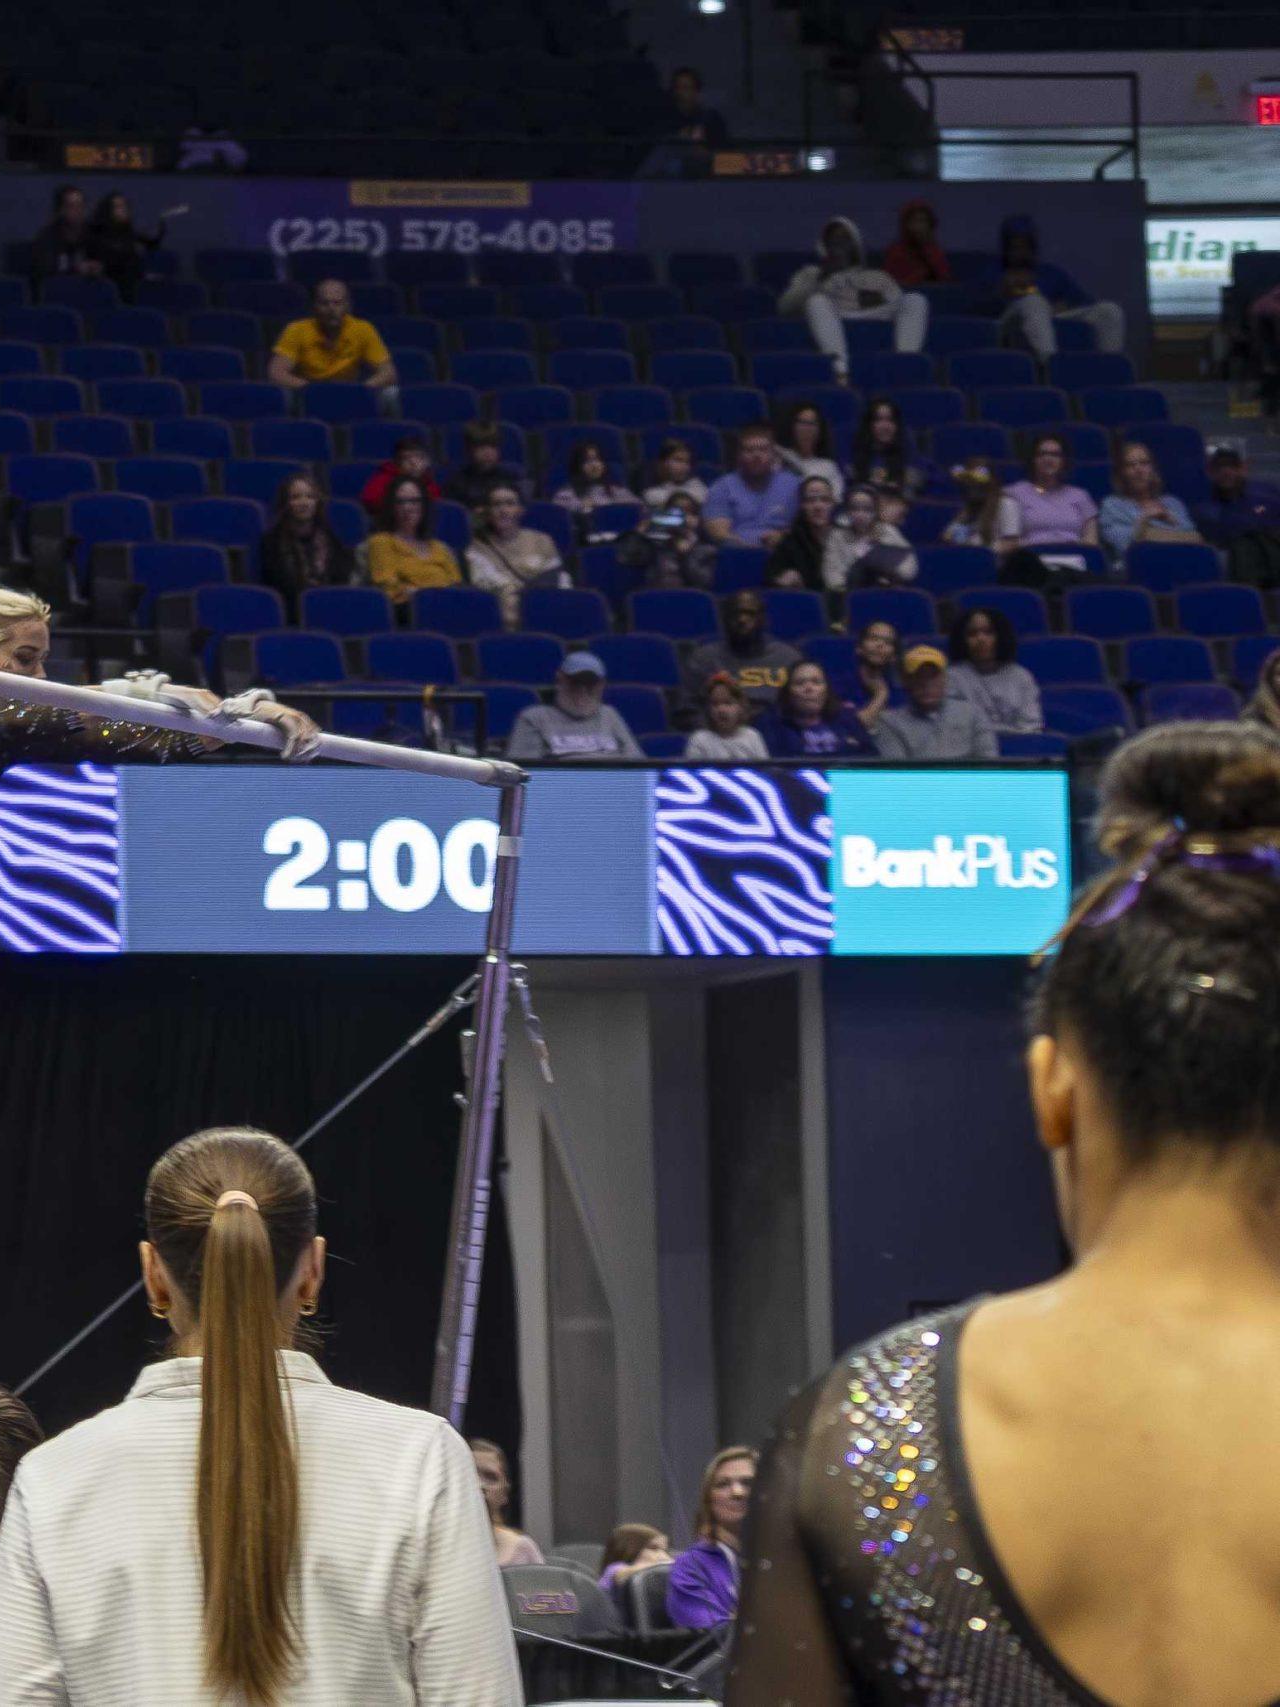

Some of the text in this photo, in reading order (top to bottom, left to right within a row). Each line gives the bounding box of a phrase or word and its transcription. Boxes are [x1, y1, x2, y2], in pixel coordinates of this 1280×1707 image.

[268, 217, 615, 256] (225) 578-4085
[263, 817, 500, 913] 2:00
[840, 835, 1060, 888] BankPlus
